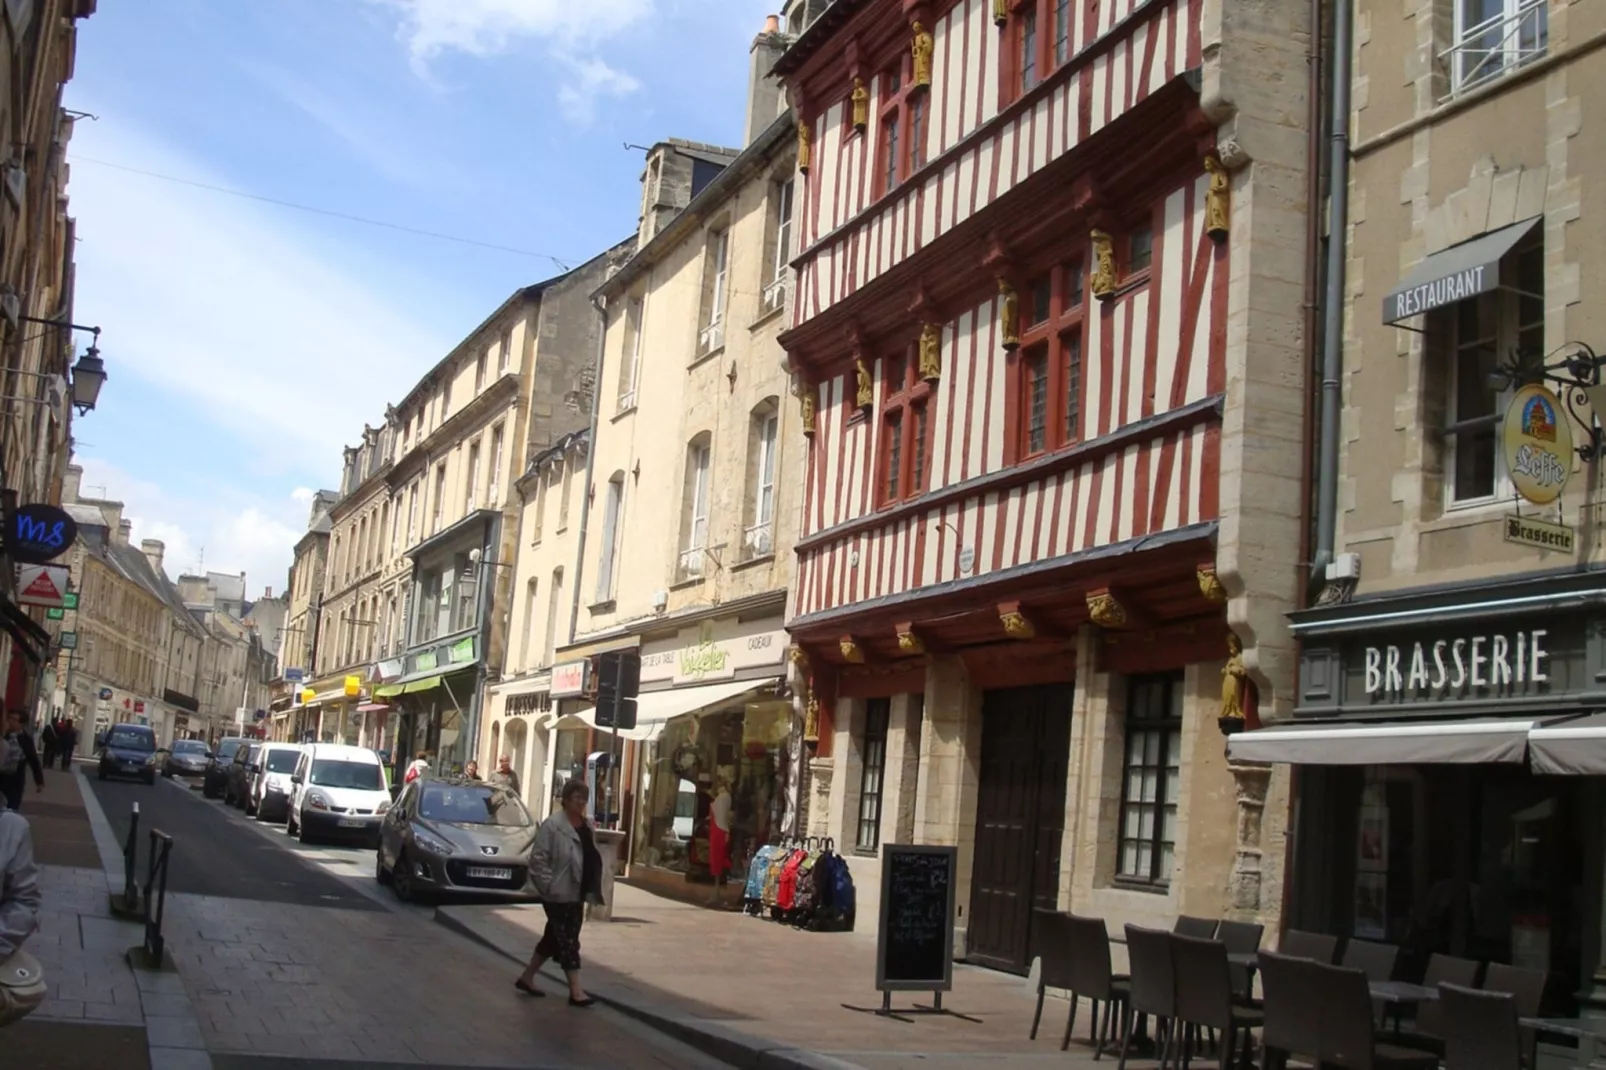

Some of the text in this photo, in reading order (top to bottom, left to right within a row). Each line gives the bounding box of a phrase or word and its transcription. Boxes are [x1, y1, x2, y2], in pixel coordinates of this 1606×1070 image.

[1396, 266, 1484, 318] RESTAURANT
[1512, 443, 1566, 488] Leffe
[1508, 519, 1571, 549] Brasserie
[748, 635, 773, 651] CADEAUX
[1365, 629, 1548, 693] BRASSERIE
